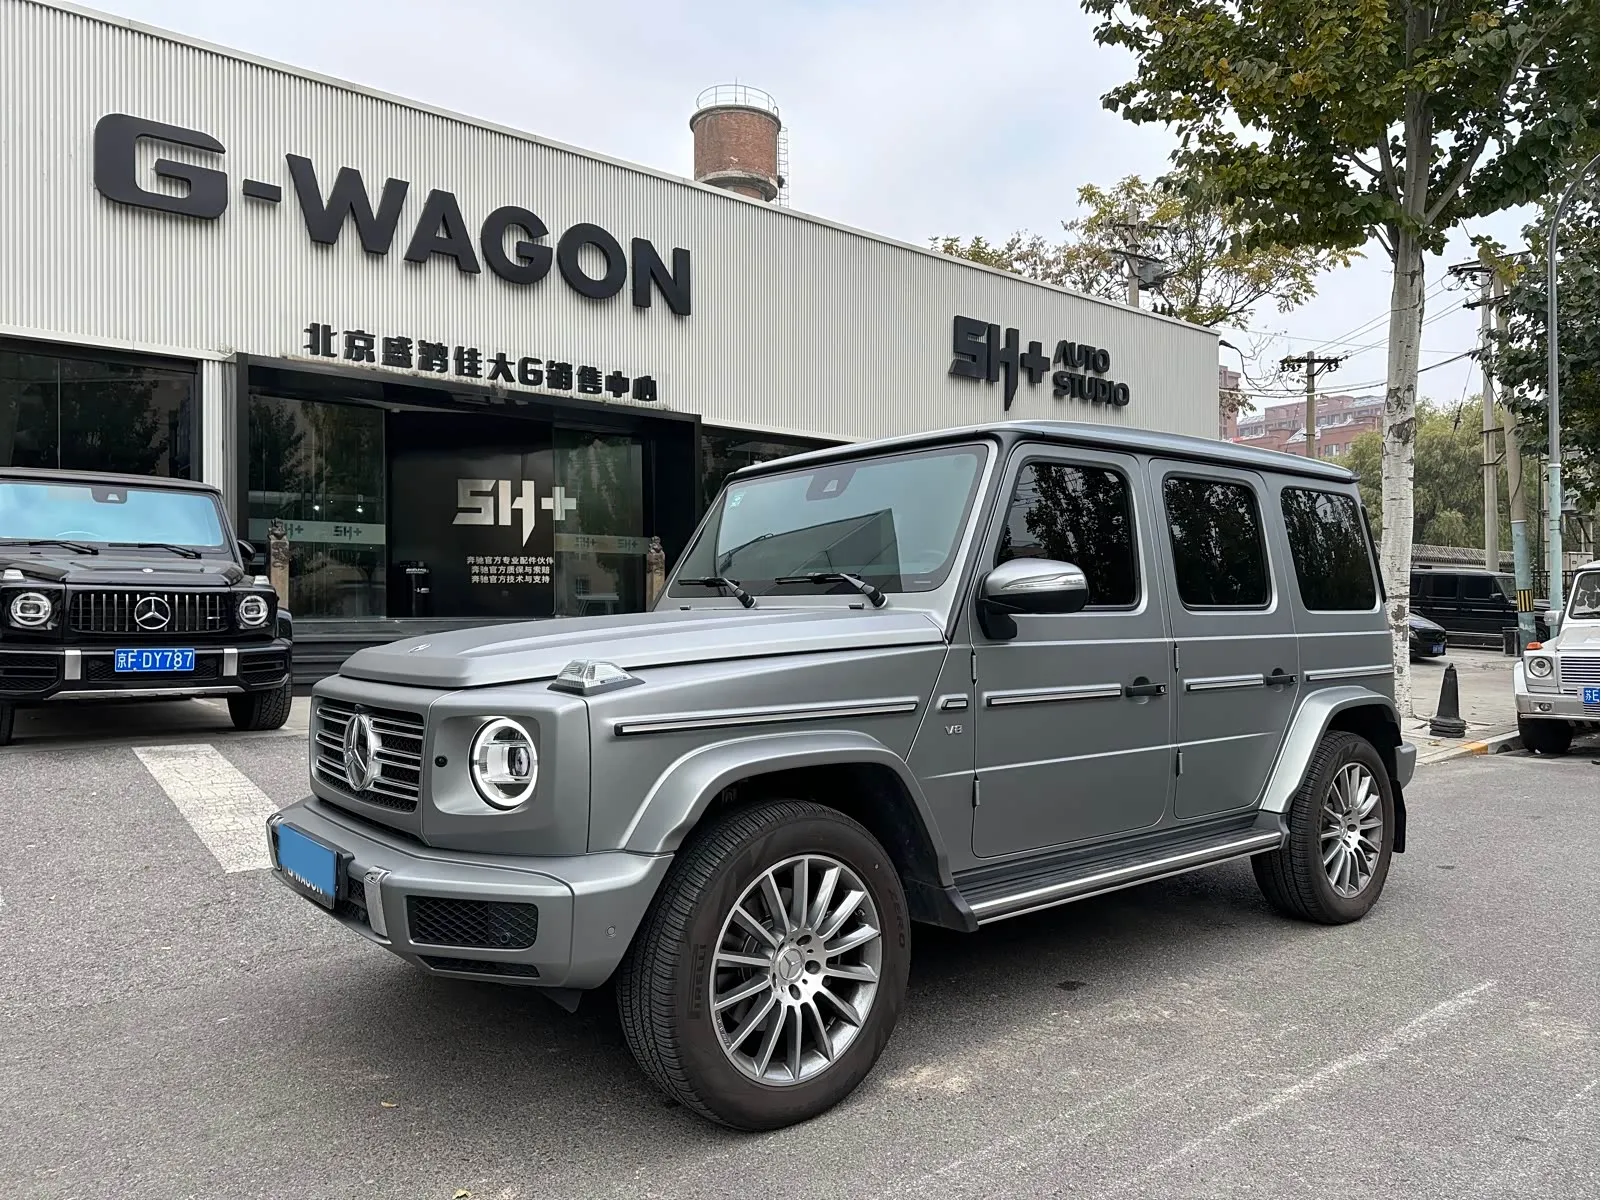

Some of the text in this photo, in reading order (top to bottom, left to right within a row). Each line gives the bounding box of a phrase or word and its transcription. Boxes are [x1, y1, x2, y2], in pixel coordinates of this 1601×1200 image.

[94, 113, 692, 316] G-WAGON
[1053, 340, 1110, 373] AUTO
[1053, 371, 1130, 407] STUDIO
[471, 575, 550, 584] 奔驰官方技术与支持
[945, 724, 963, 735] V8
